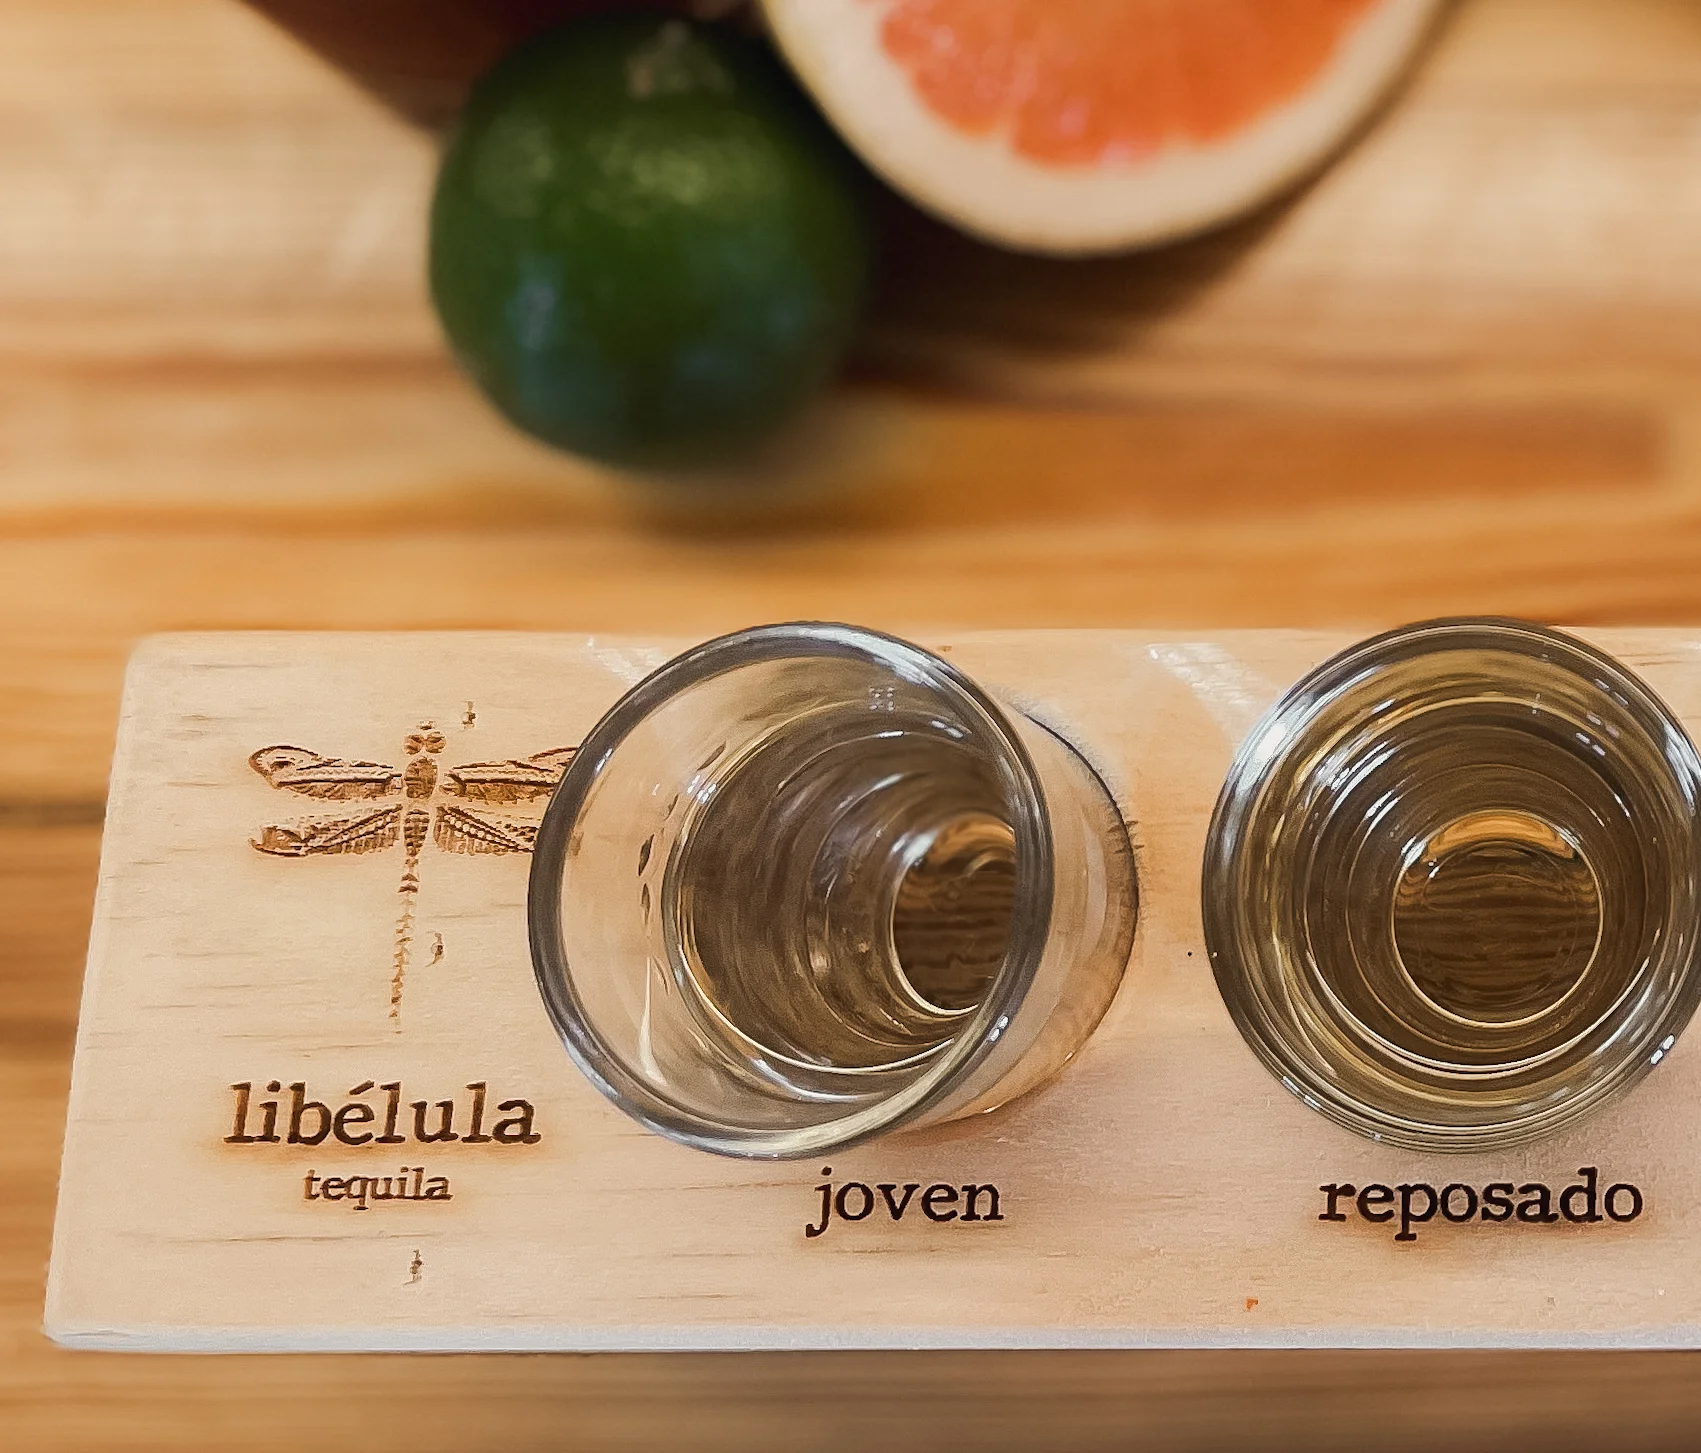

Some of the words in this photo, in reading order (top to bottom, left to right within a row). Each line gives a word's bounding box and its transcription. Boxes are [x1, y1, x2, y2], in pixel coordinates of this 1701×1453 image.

[224, 1081, 541, 1146] libélula
[305, 1167, 453, 1211] tequila
[805, 1166, 1005, 1238] joven
[1318, 1167, 1644, 1242] reposado
